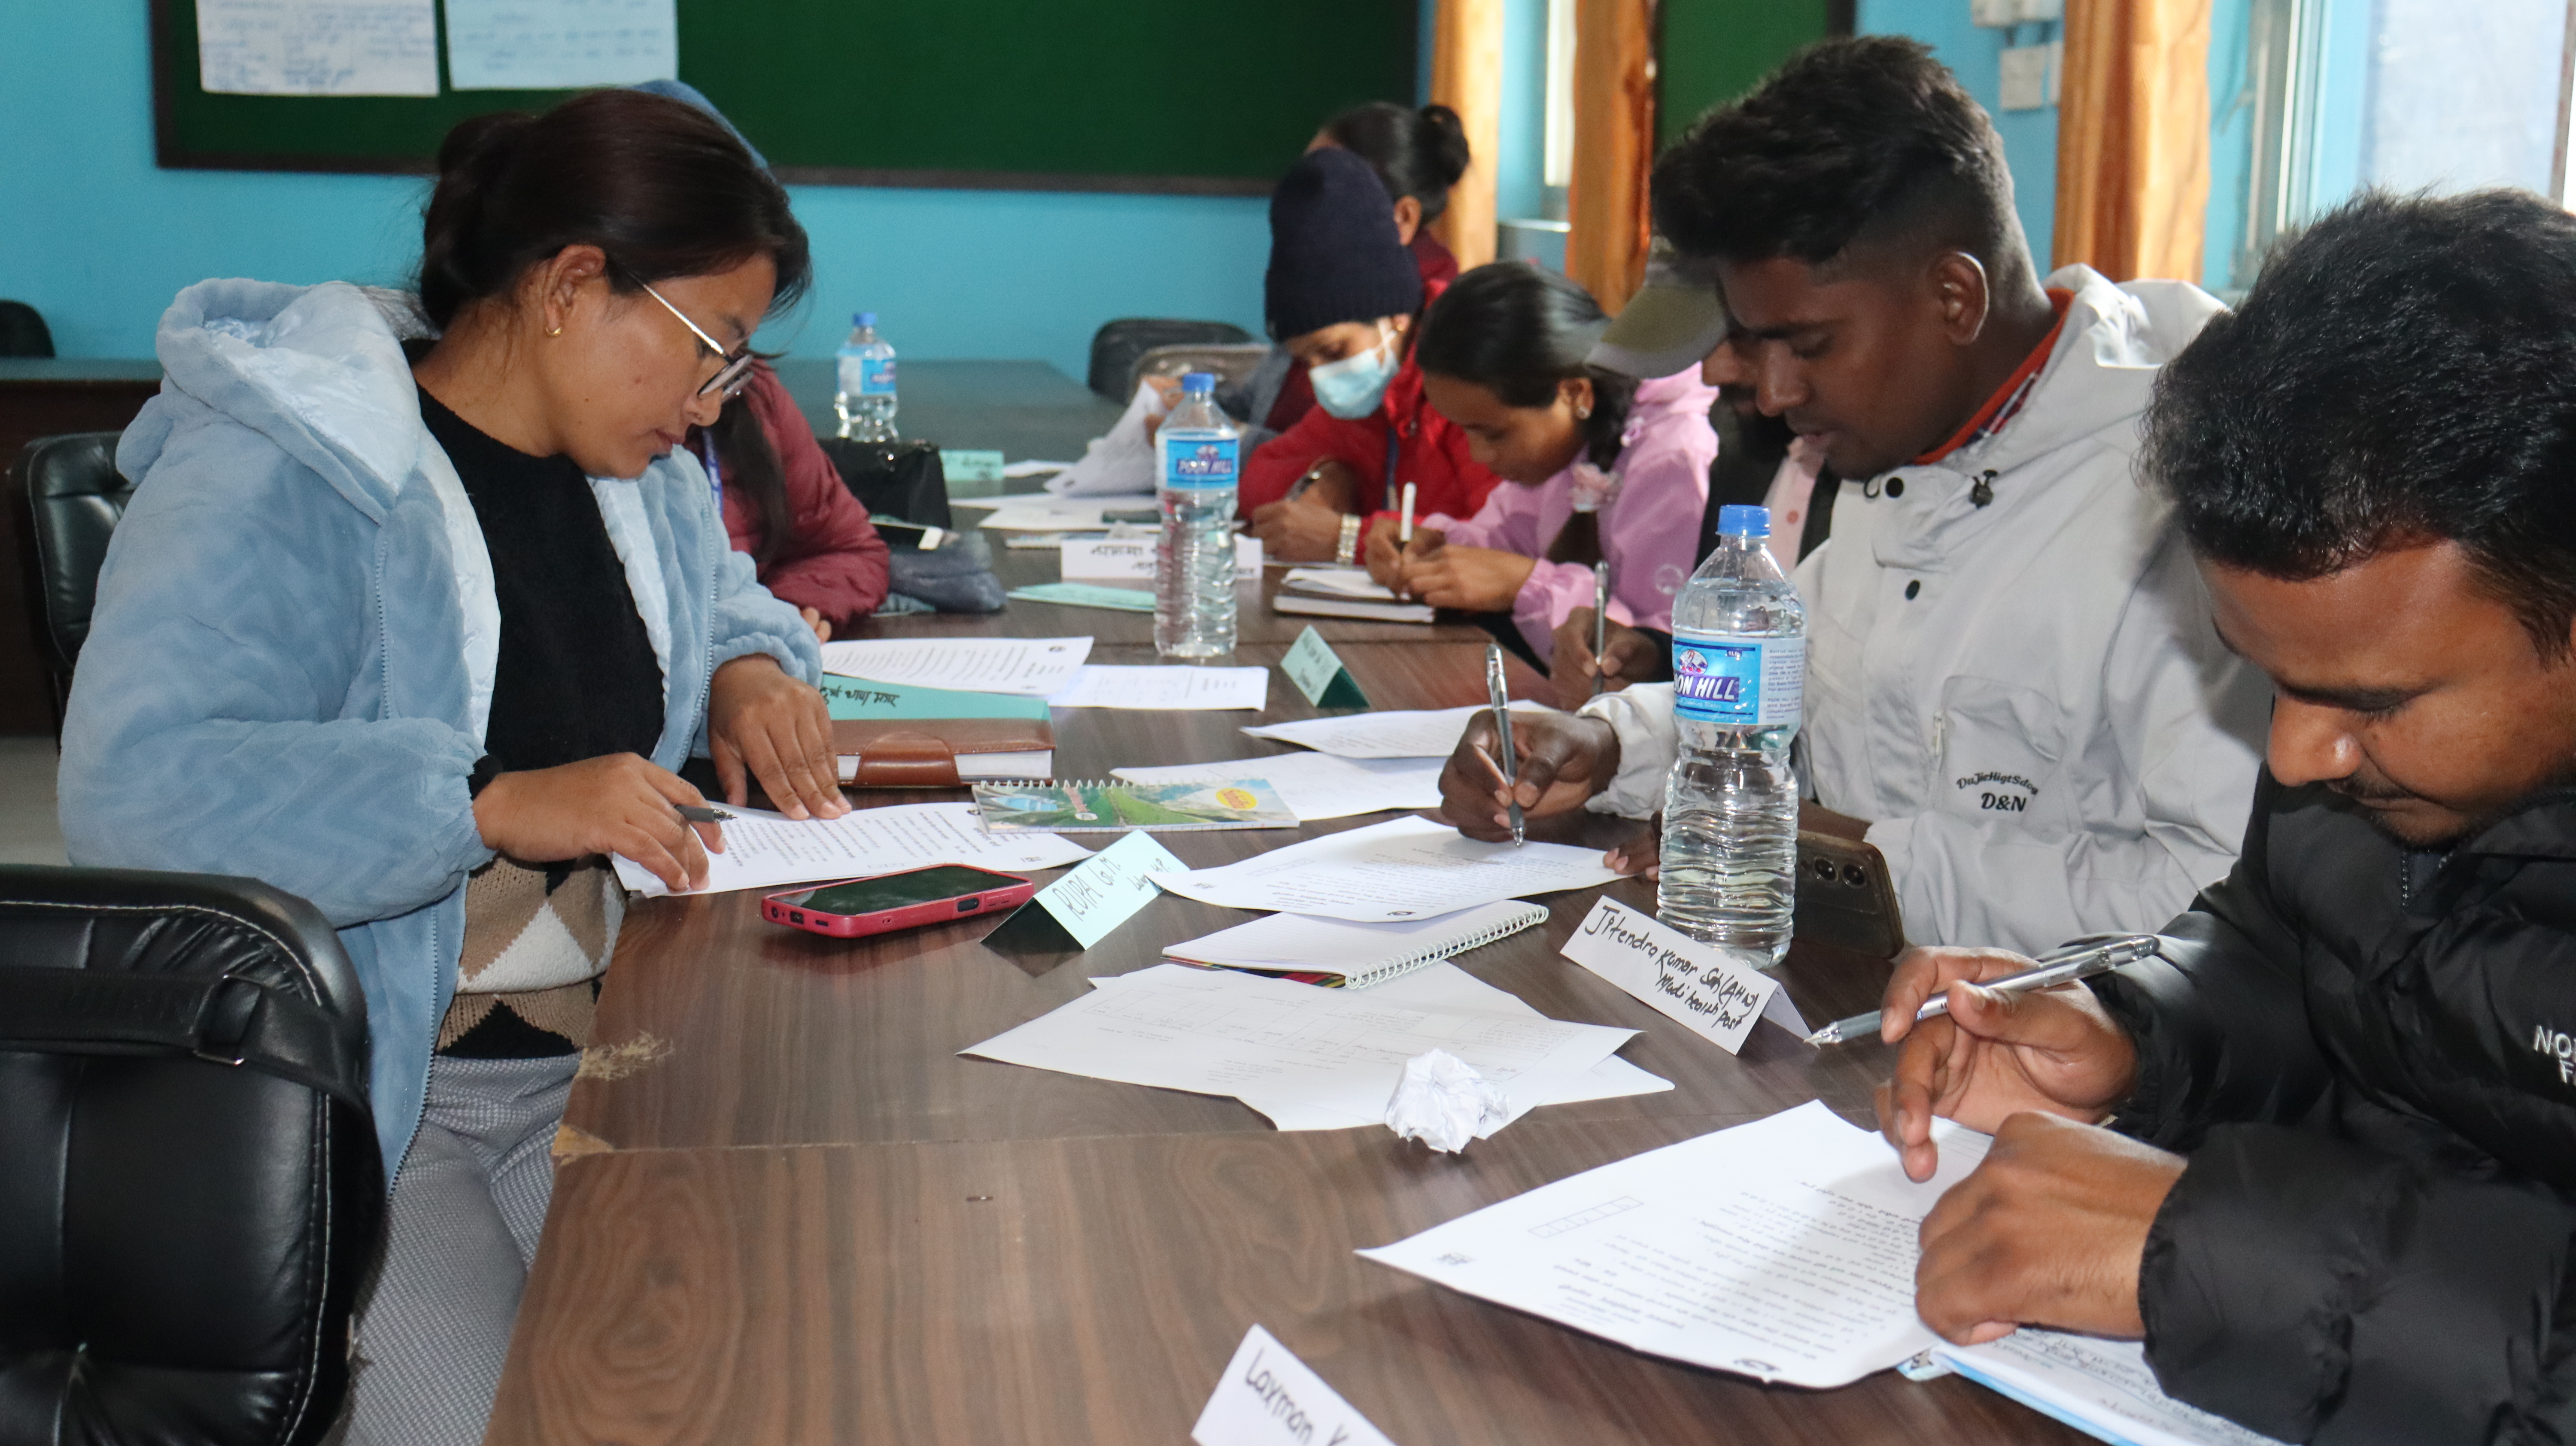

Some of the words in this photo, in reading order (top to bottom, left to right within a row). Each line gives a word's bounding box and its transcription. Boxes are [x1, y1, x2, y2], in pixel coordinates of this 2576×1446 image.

[1695, 678, 1735, 700] HILL
[1981, 793, 2026, 812] D&N
[1052, 874, 1103, 922] RUPA
[1584, 905, 1658, 959] Jitendra
[1655, 949, 1698, 978] Kumar
[1684, 990, 1719, 1016] health
[2533, 1025, 2576, 1063] NO
[2559, 1058, 2576, 1087] F
[1244, 1347, 1314, 1446] Laxman
